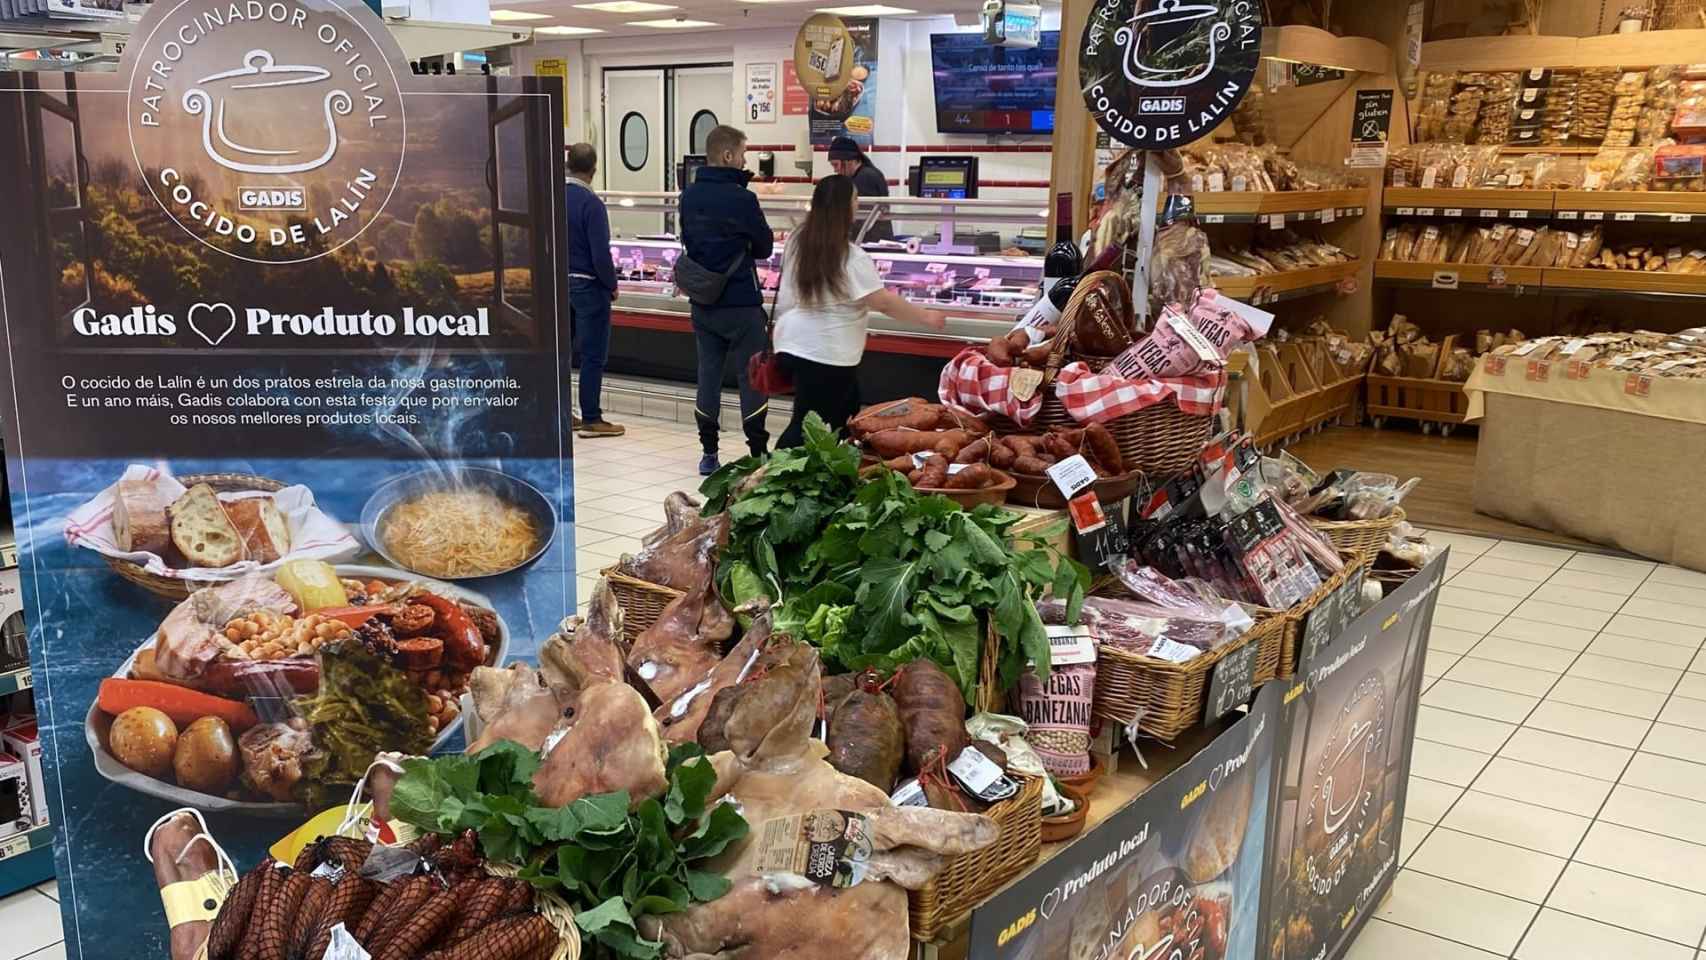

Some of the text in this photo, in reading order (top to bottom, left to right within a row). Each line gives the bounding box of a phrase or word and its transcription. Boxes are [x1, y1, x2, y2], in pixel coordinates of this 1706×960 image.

[141, 1, 388, 127] PATROCINADOR OFICIAL
[751, 103, 758, 120] 6
[1091, 80, 1240, 141] COCIDO DE LALÍN
[1141, 100, 1184, 112] GADIS
[1358, 109, 1389, 120] gluten
[1365, 101, 1378, 109] sin
[160, 167, 377, 246] COCIDO DE LALÍN
[241, 189, 303, 207] GADIS
[73, 305, 490, 336] Gadis Produto local
[1199, 317, 1231, 348] VEGAS
[1138, 339, 1171, 375] VEGAS
[62, 375, 521, 392] O cocido de Lalín é un dos pratos estrela da nosa gastronomía.
[67, 393, 519, 410] E un ano máis, Gadis colabora con esta festa que pon en valor
[170, 411, 421, 428] os nosos mellores produtos locais.
[824, 845, 836, 877] CABEZA
[997, 822, 1150, 947] GADIS Produto local
